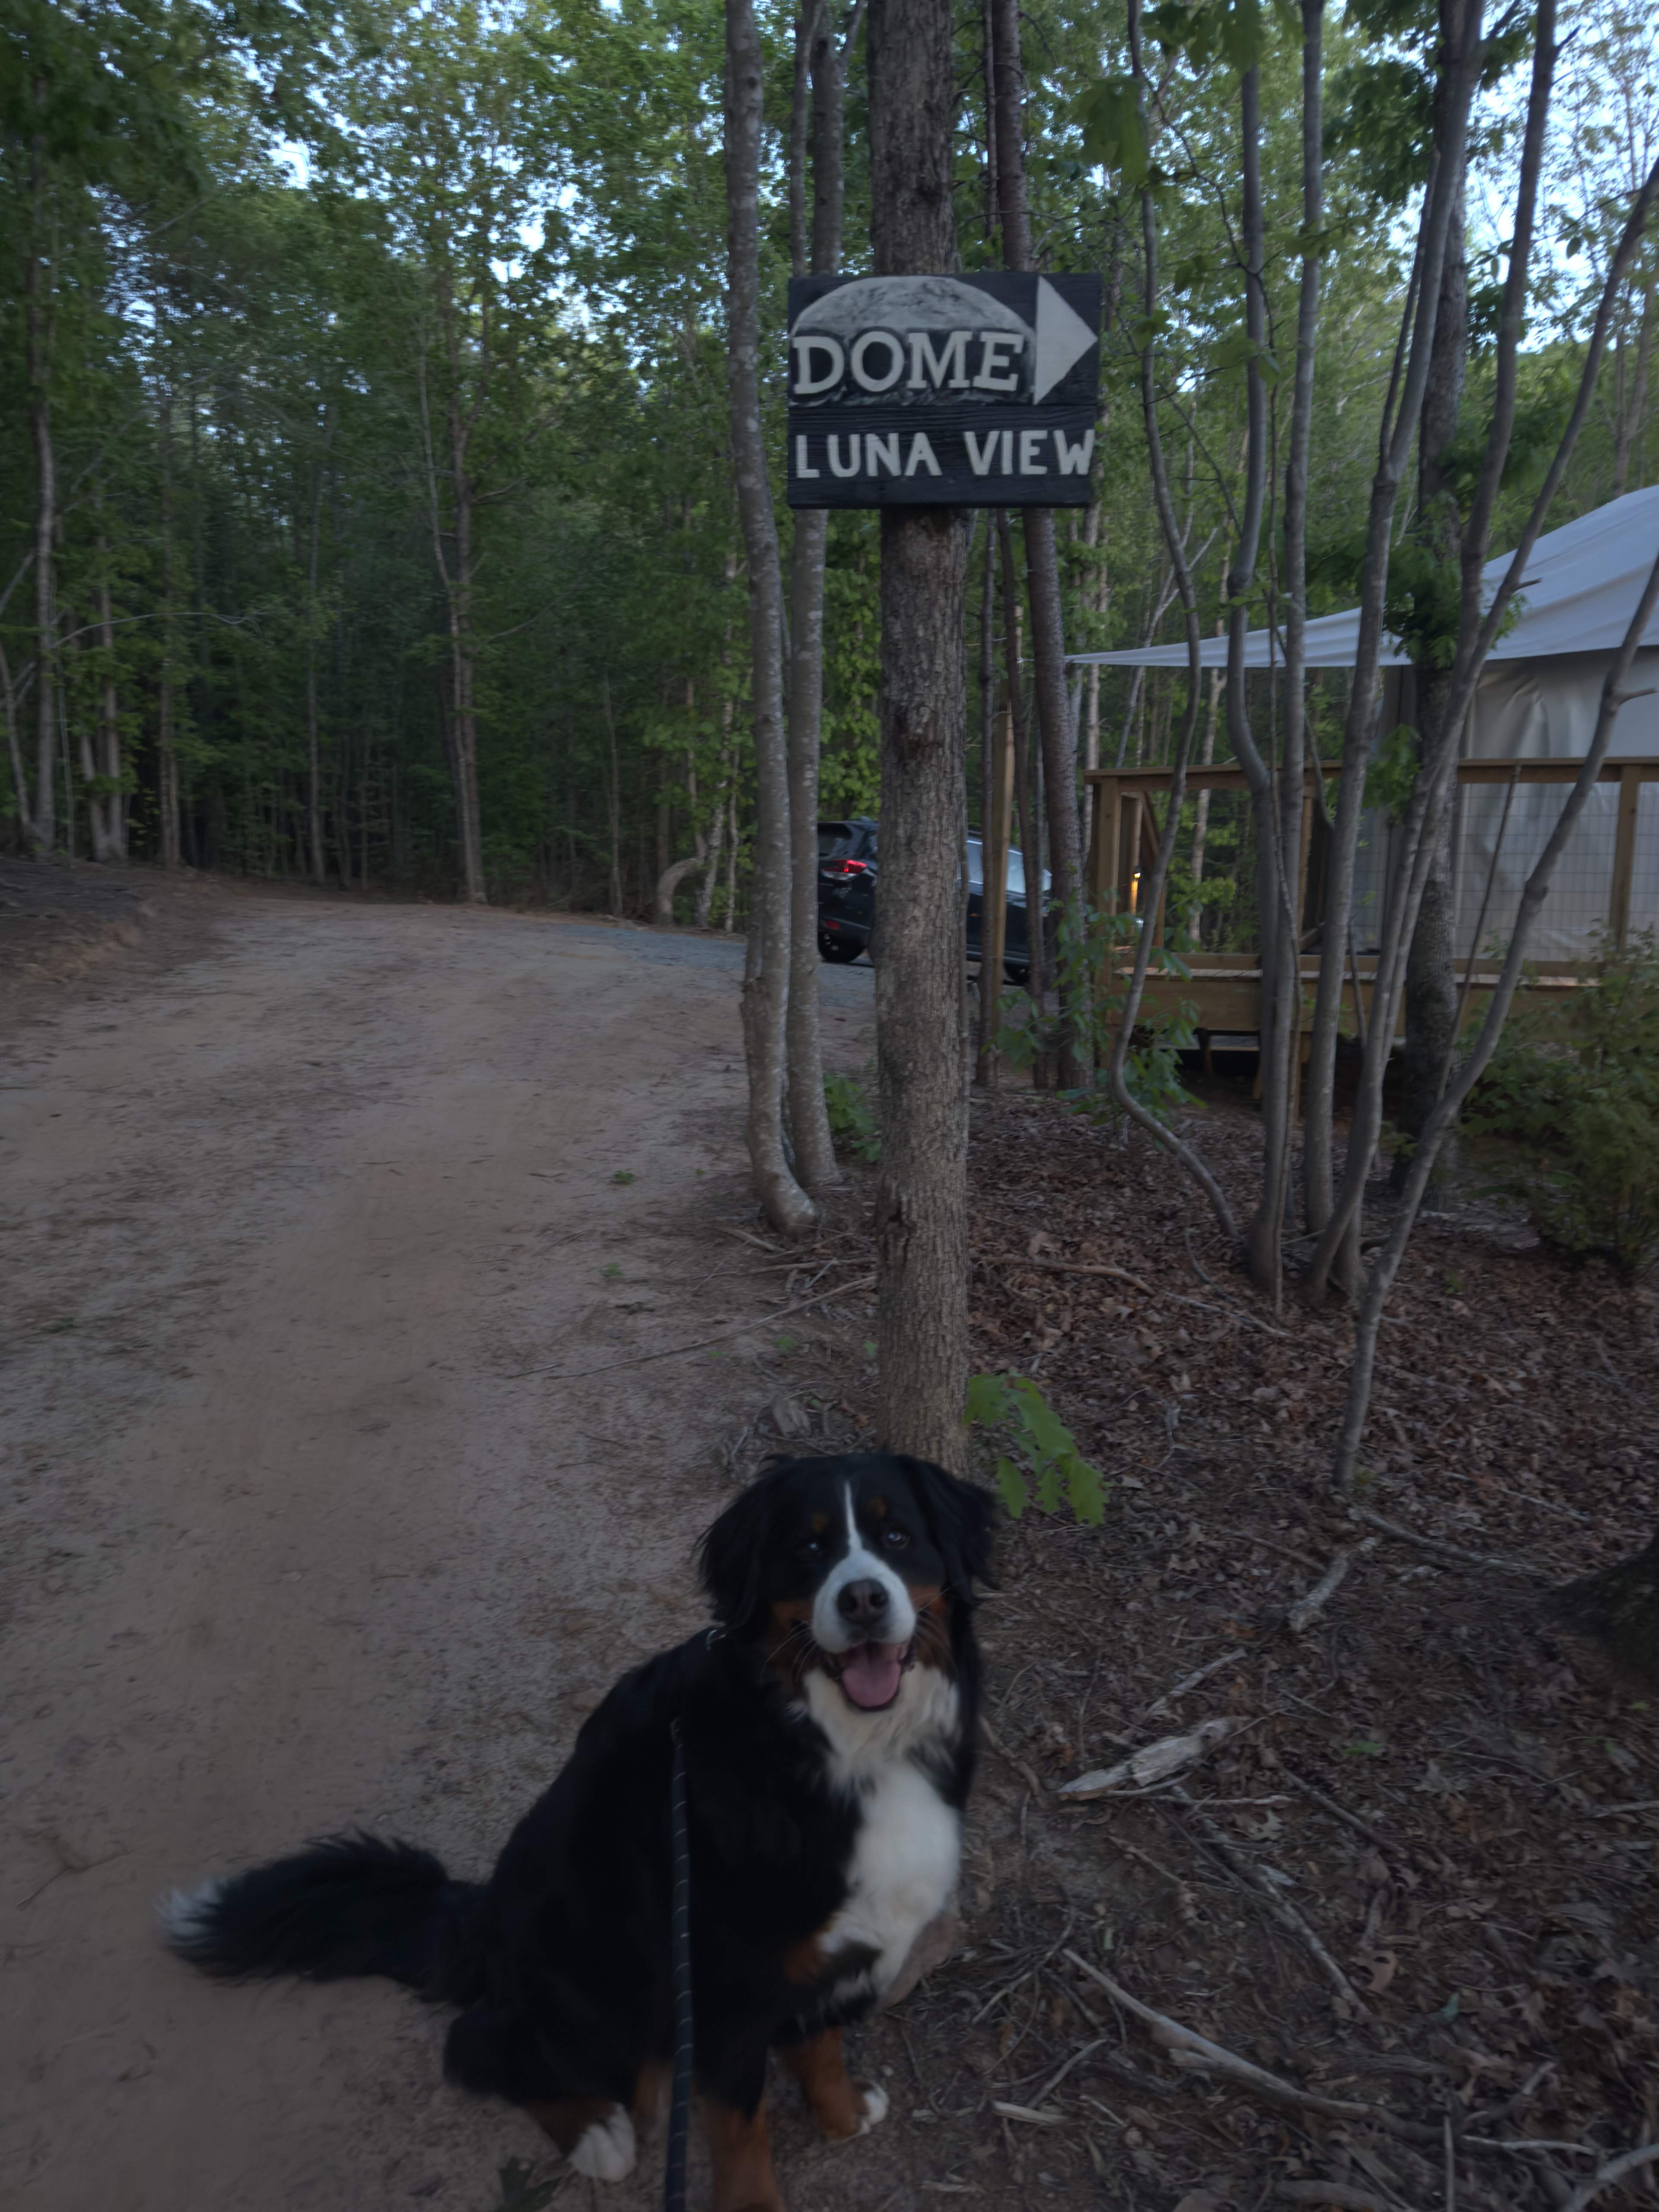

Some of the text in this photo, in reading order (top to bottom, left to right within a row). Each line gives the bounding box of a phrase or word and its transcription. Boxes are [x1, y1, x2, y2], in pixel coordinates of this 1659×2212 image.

[792, 331, 1024, 394] DOME
[795, 429, 1095, 478] LUNA VIEW
